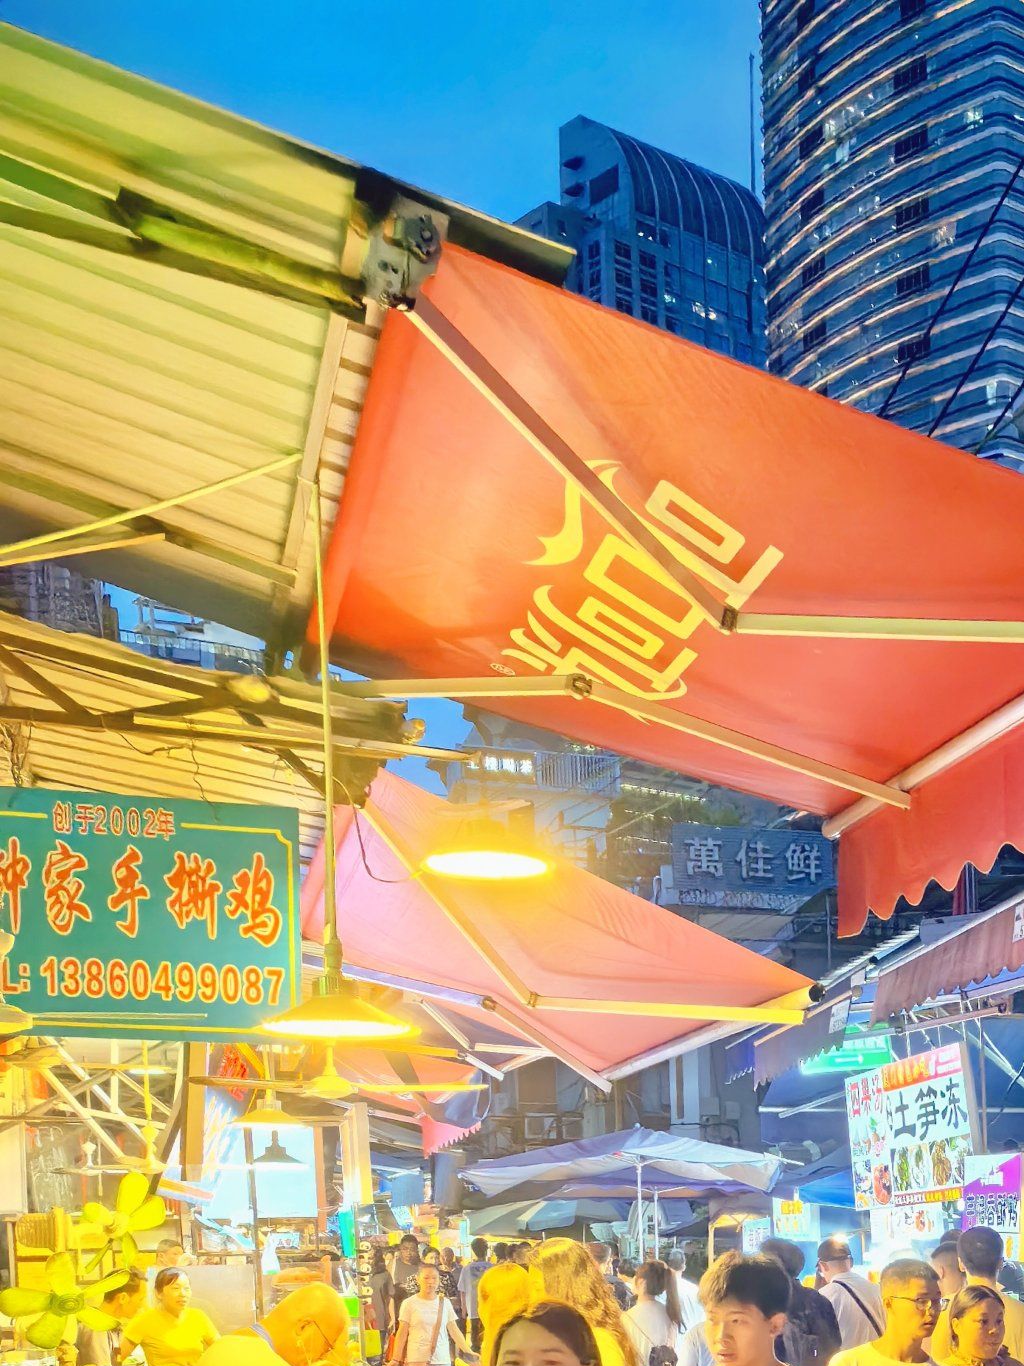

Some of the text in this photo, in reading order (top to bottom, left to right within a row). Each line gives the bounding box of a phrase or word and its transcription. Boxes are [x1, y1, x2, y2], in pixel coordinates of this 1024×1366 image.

[53, 800, 176, 840] 创于2002年
[684, 837, 823, 884] 萬佳鲜
[40, 956, 284, 1005] 13860499087
